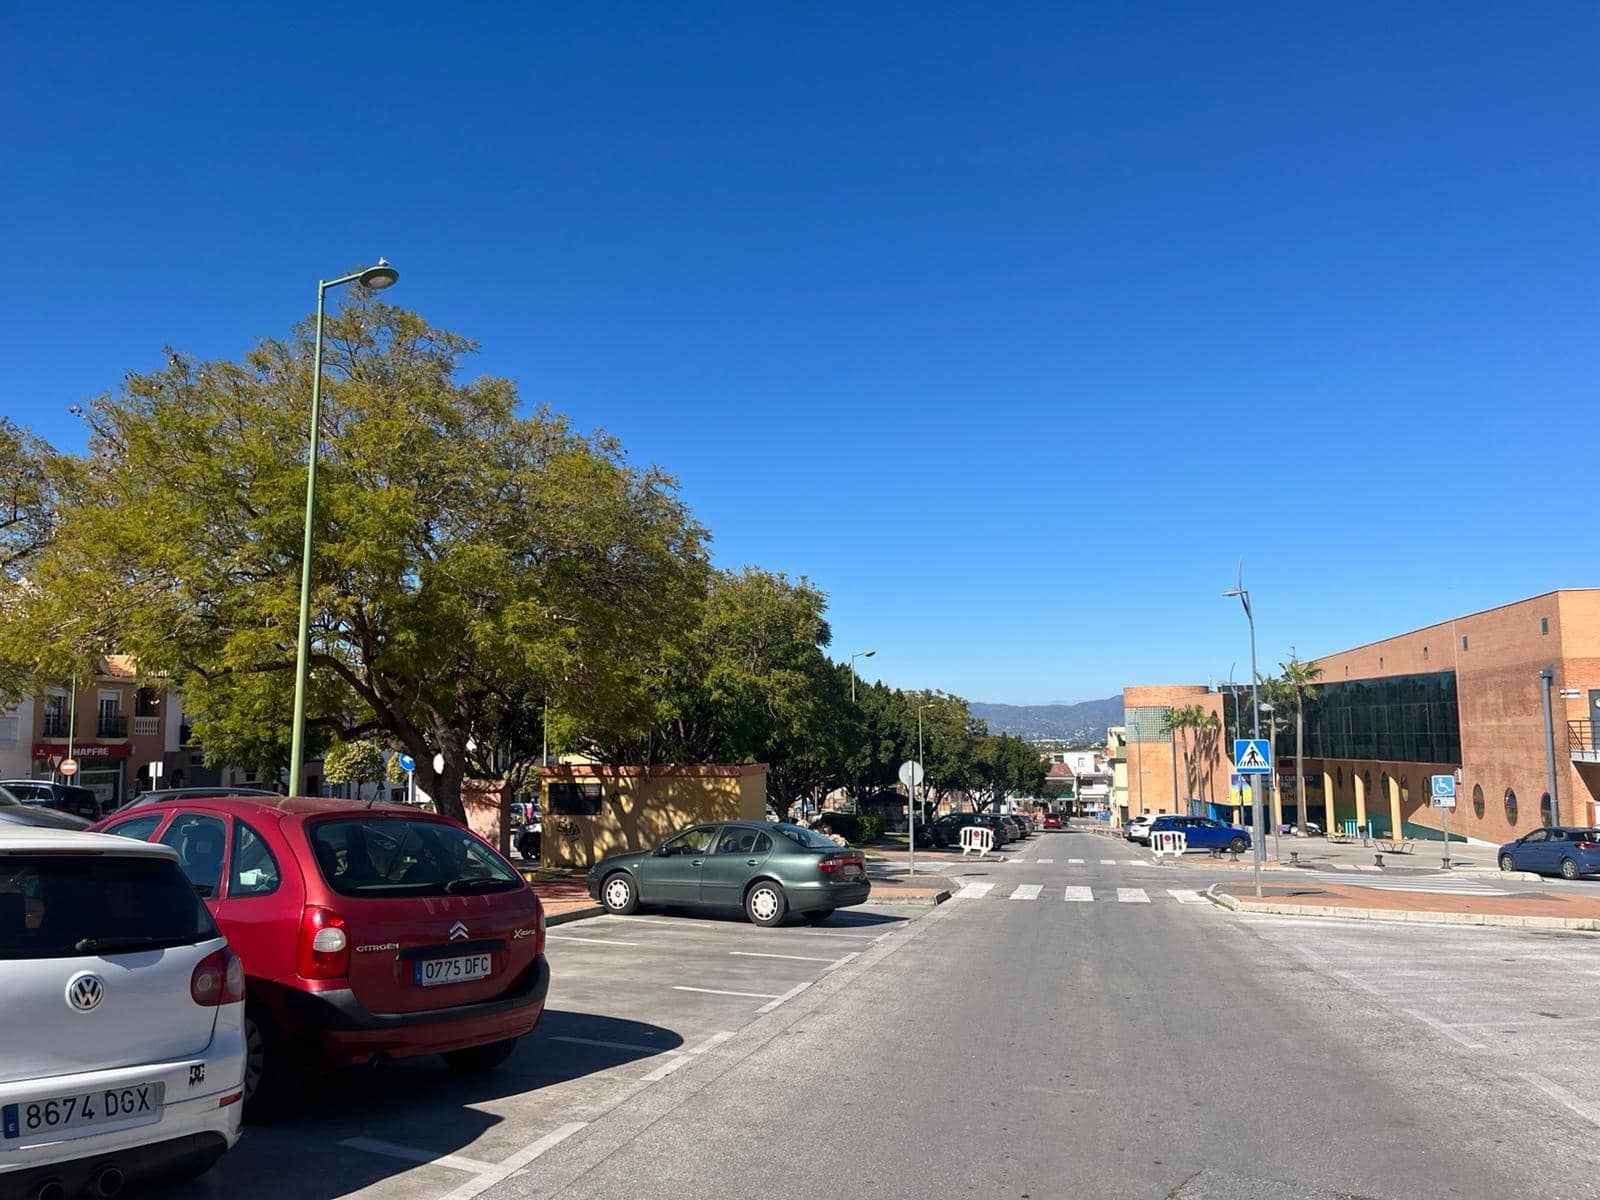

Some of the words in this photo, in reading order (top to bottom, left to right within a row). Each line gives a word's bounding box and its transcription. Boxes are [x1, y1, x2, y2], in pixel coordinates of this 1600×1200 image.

[73, 747, 109, 756] MAPFRE
[425, 960, 461, 979] 0775
[465, 956, 489, 975] DFC
[26, 1095, 95, 1130] 8674
[105, 1087, 151, 1117] DGX
